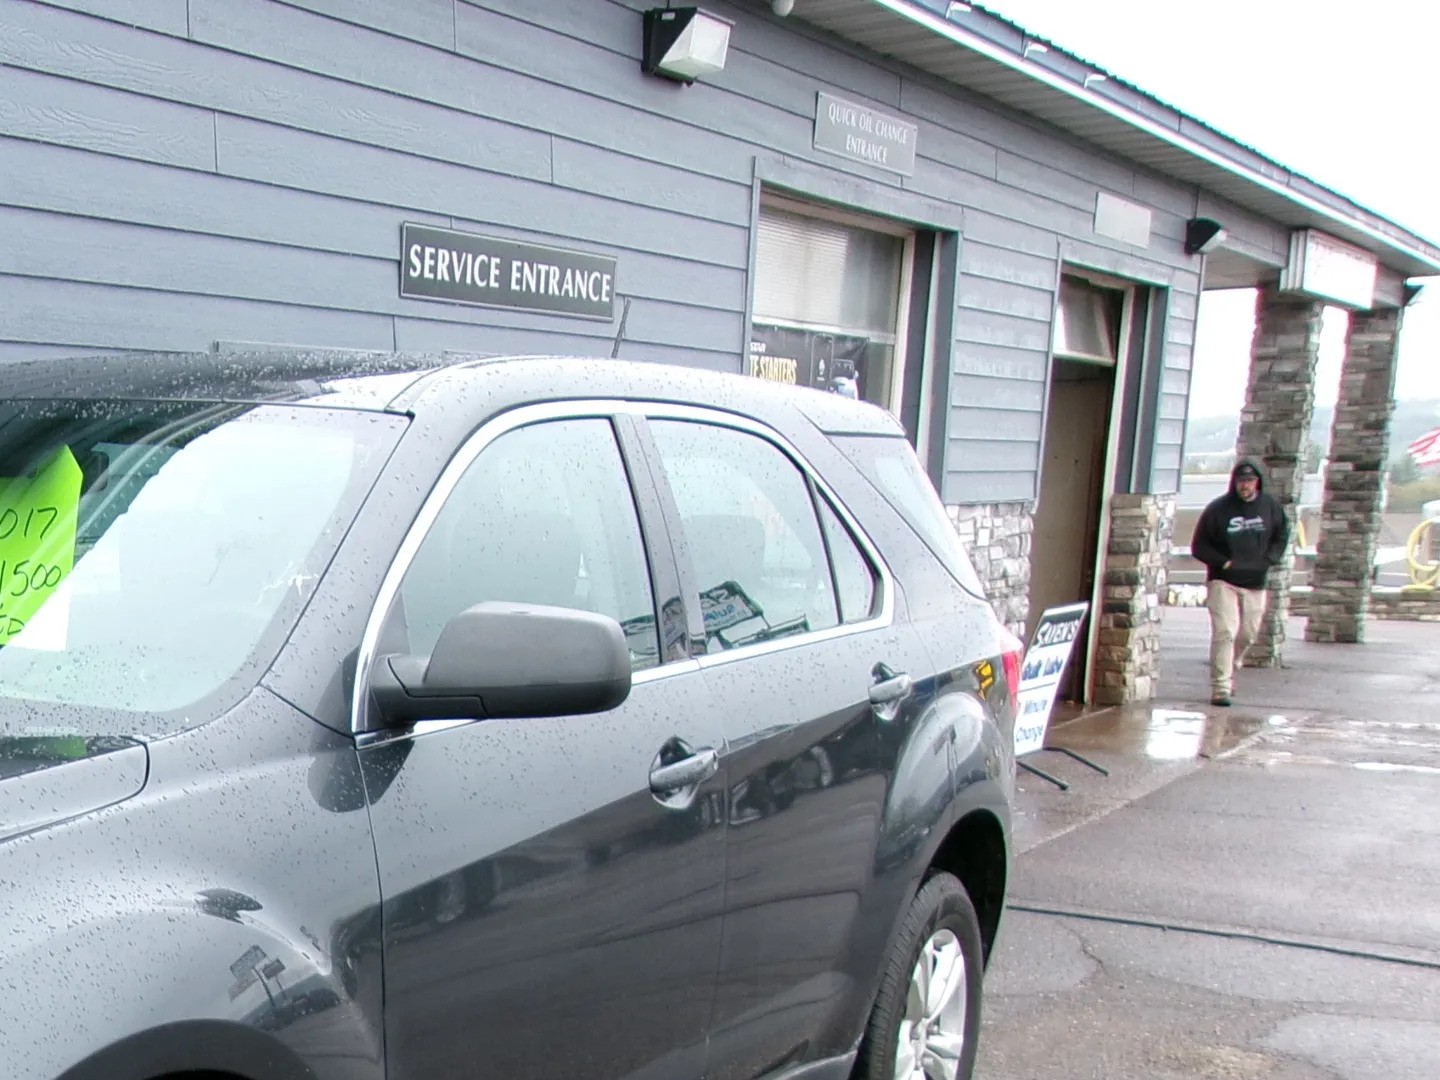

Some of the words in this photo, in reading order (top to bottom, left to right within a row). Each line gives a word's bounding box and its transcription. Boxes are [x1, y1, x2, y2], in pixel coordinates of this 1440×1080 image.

[828, 102, 856, 127] QUICK
[859, 113, 873, 133] OIL
[875, 120, 908, 144] CHANGE
[846, 134, 887, 163] ENTRANCE
[409, 243, 500, 288] SERVICE
[510, 260, 611, 302] ENTRANCE
[759, 356, 797, 384] STARTERS
